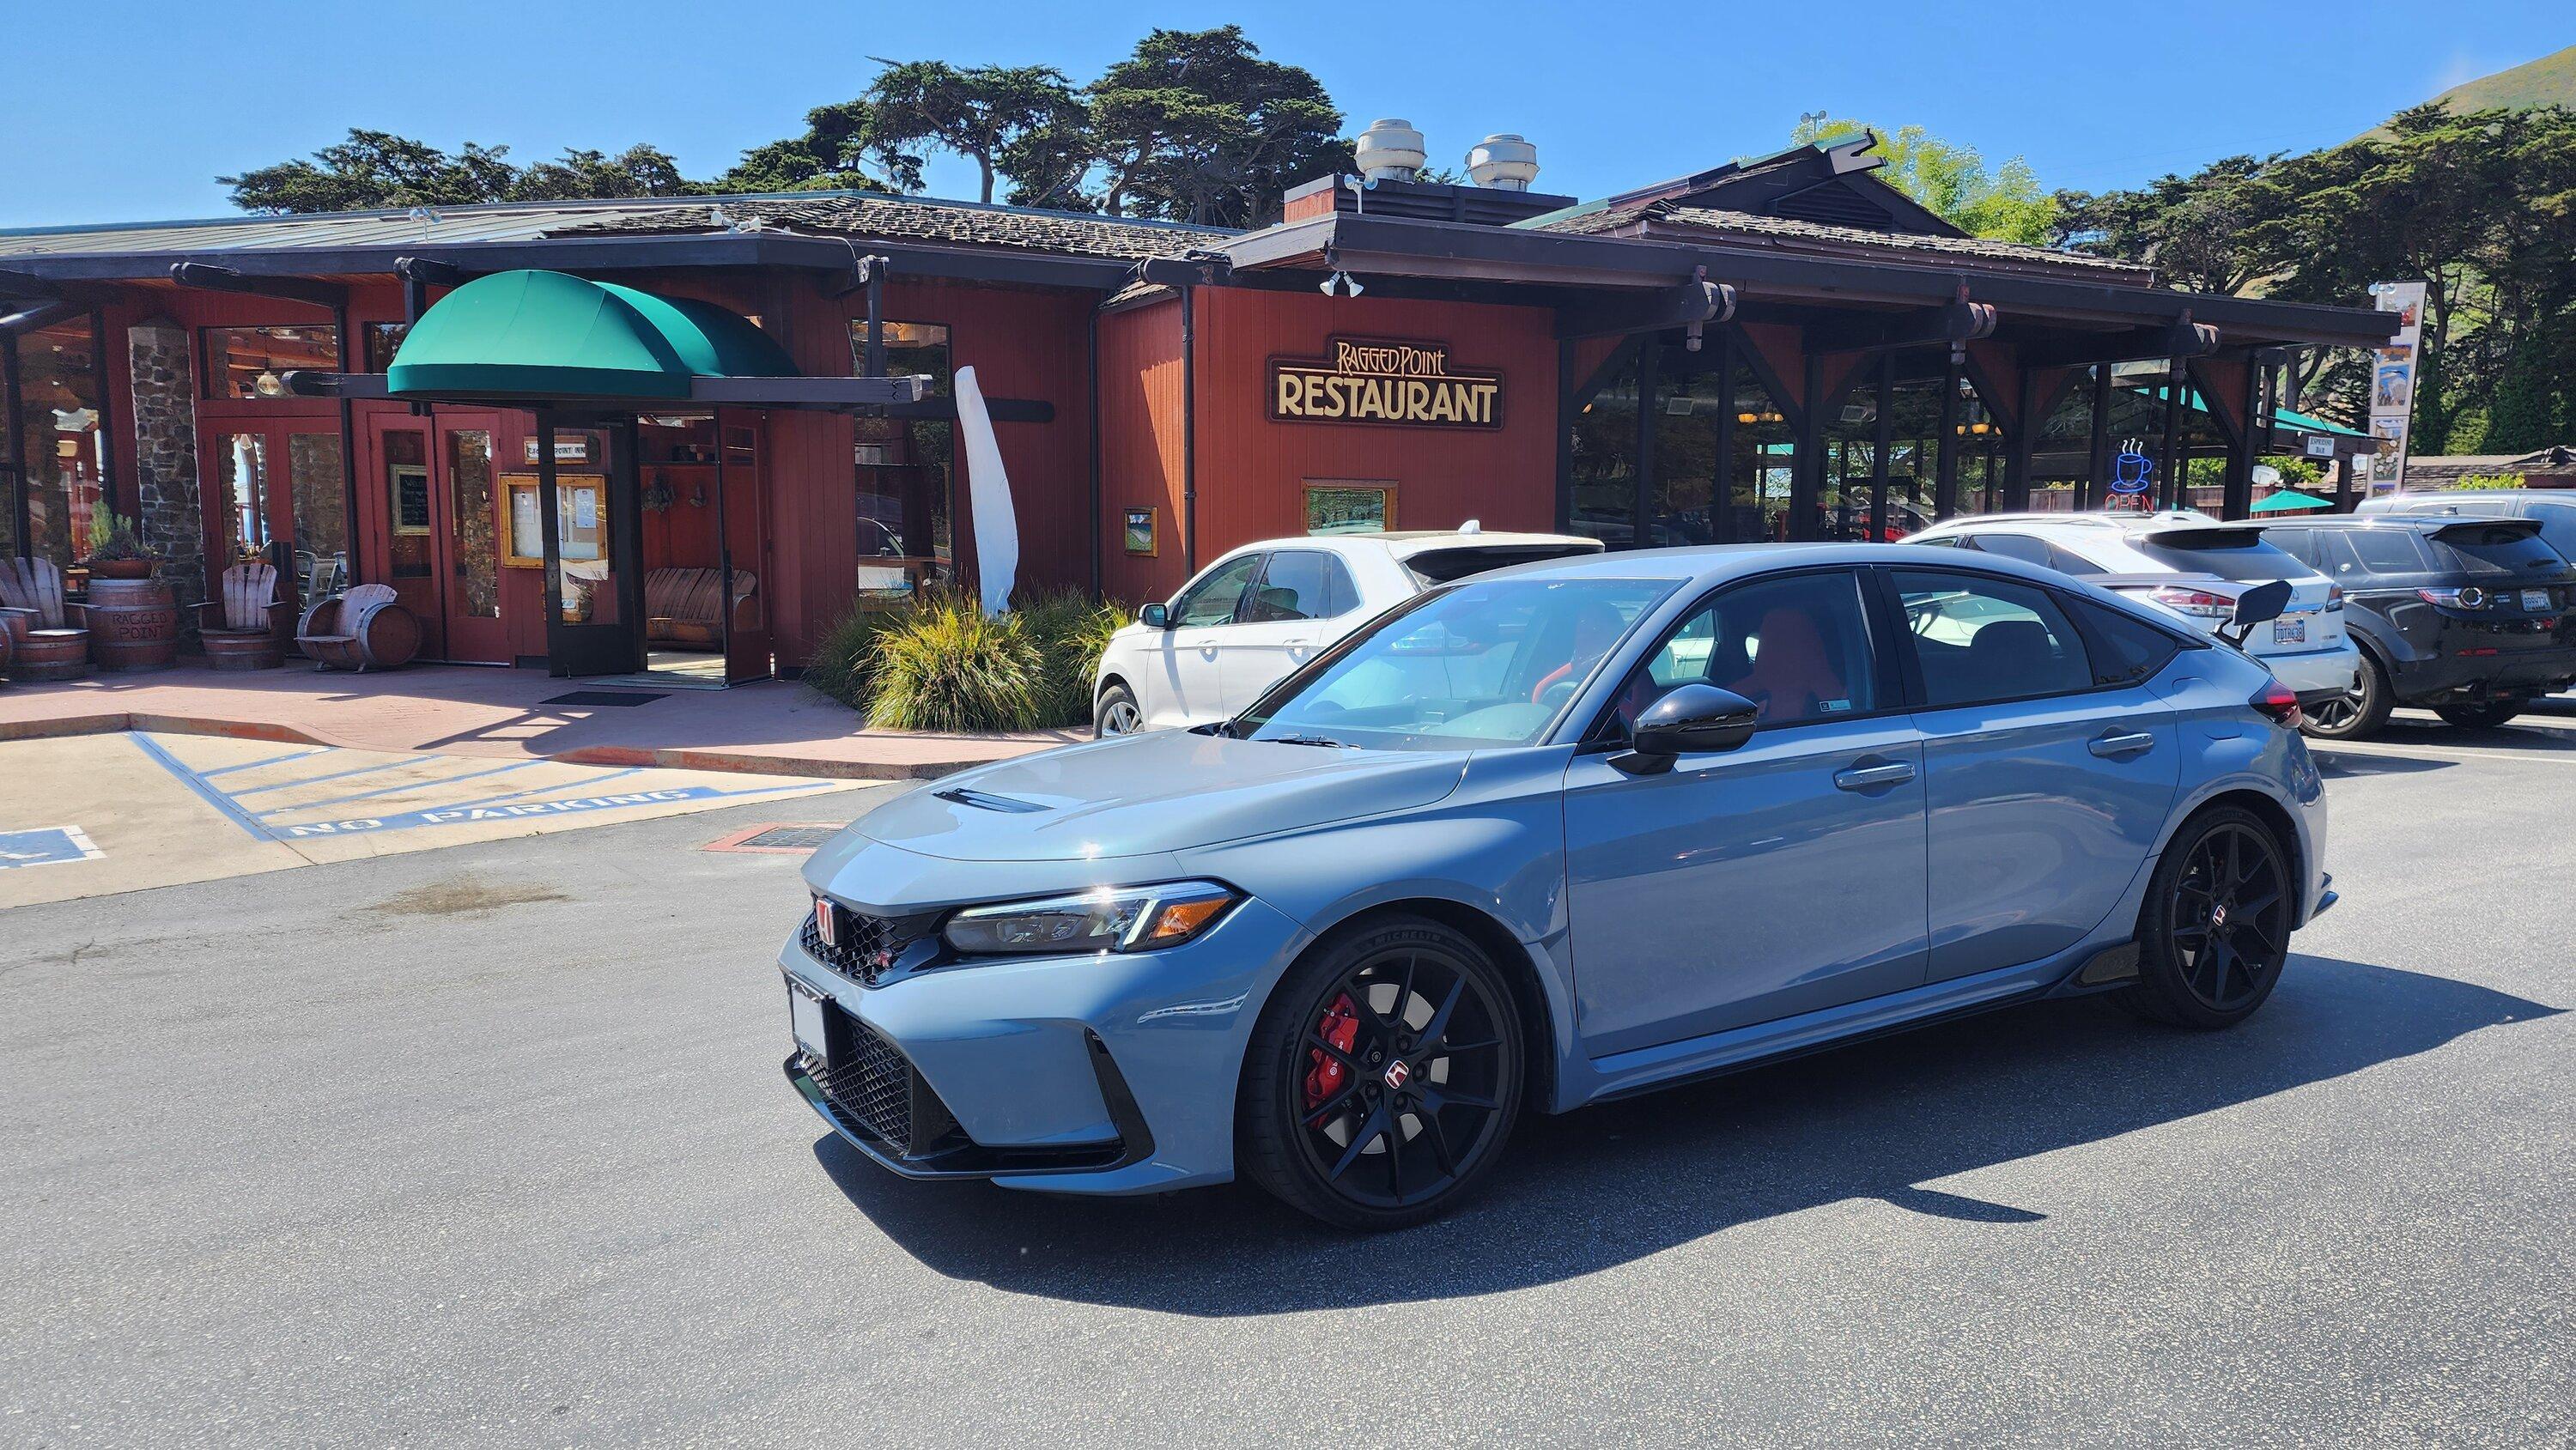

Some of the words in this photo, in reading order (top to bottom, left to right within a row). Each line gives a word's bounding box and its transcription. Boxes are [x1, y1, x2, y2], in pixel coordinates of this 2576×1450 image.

[1278, 374, 1498, 422] RESTAURANT
[2105, 494, 2154, 513] OPEN
[112, 612, 167, 625] RAGGED
[119, 625, 164, 640] POINT
[289, 818, 382, 836] NO
[420, 790, 688, 824] PARKING
[1374, 930, 1442, 944] MICHELIN
